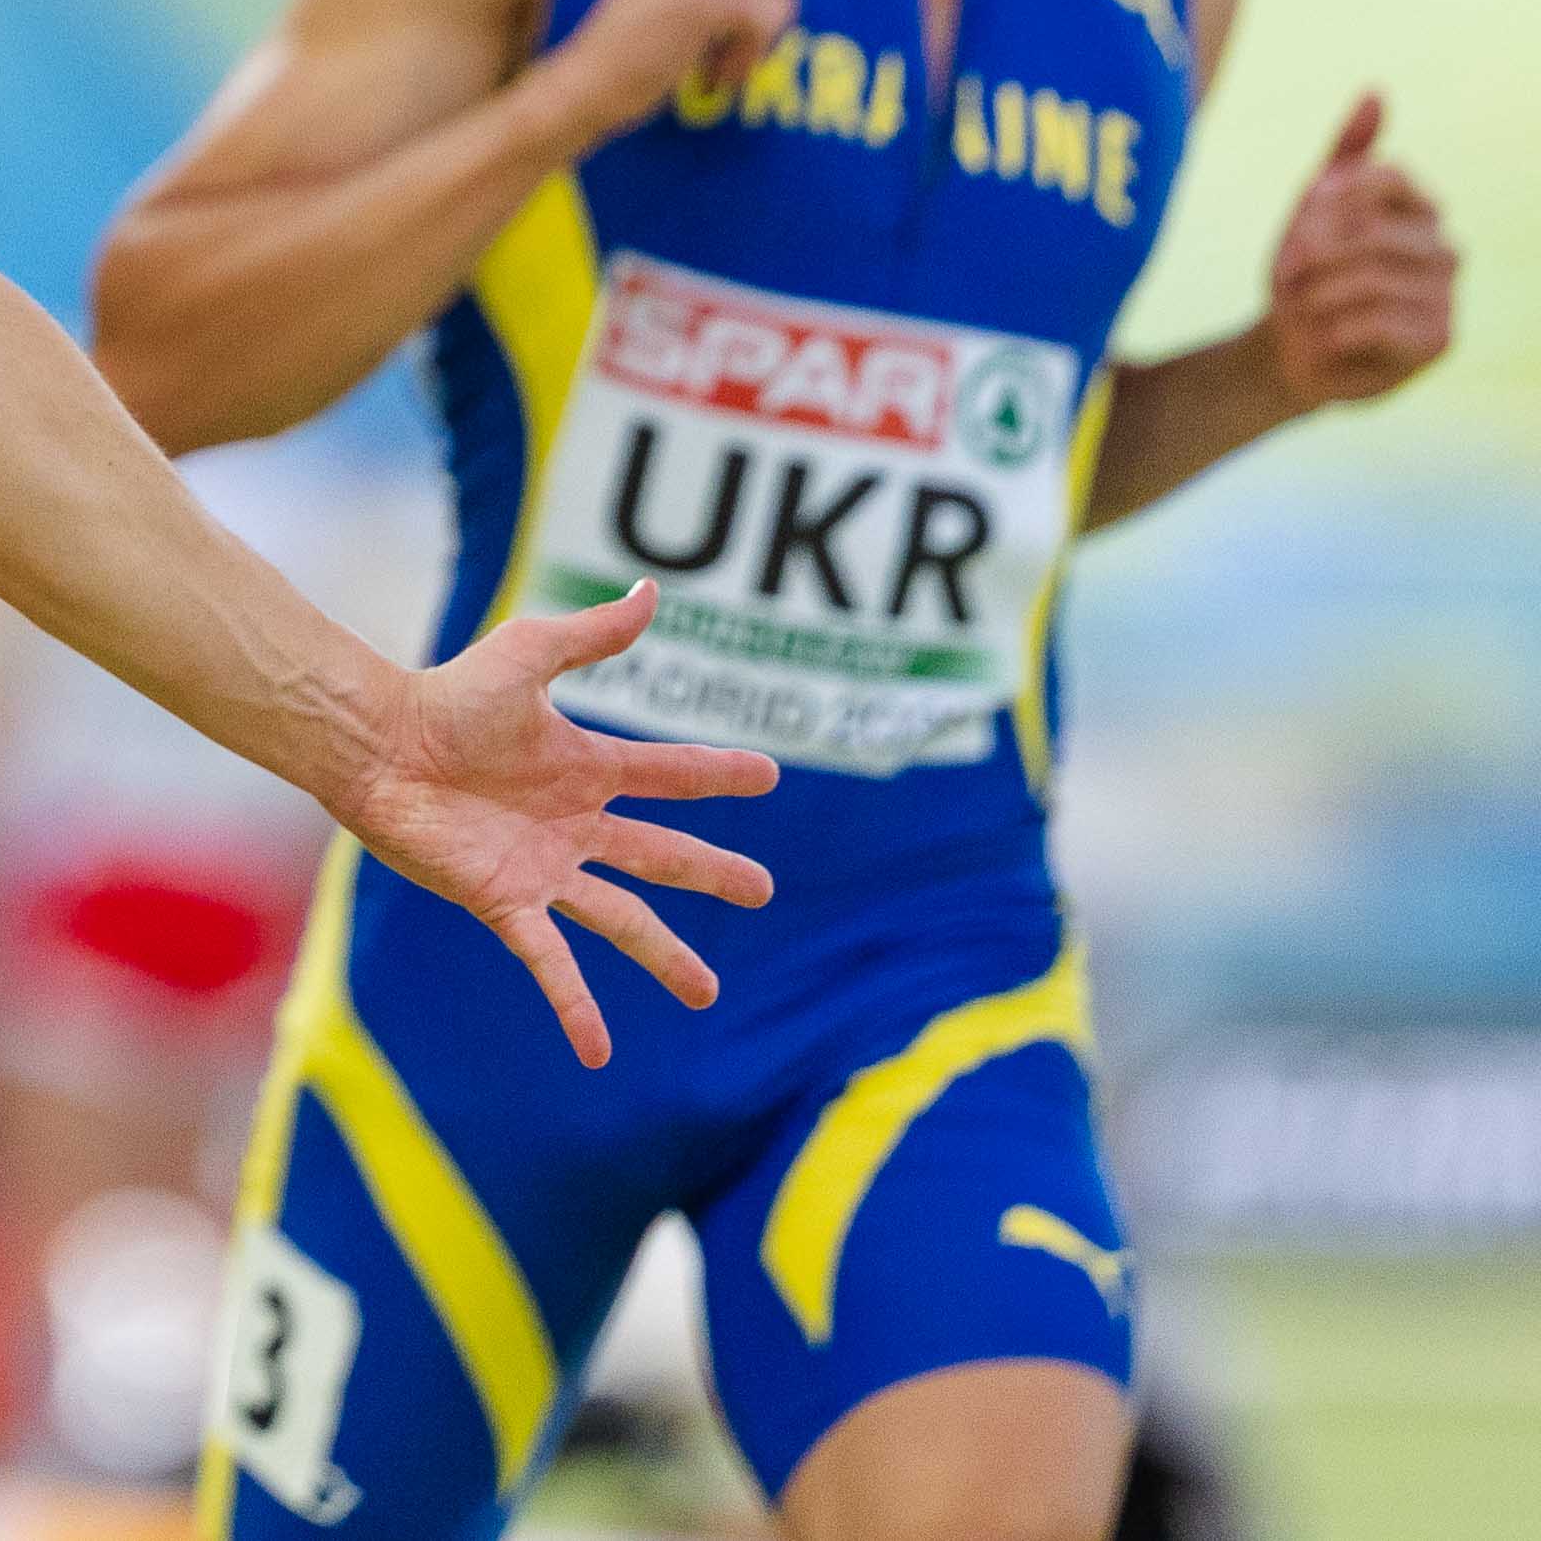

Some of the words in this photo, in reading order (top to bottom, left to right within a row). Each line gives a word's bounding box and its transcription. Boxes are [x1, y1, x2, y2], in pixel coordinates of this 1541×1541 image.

[610, 290, 943, 433] SPAR
[610, 413, 995, 626] UKR
[239, 1286, 294, 1432] 3
